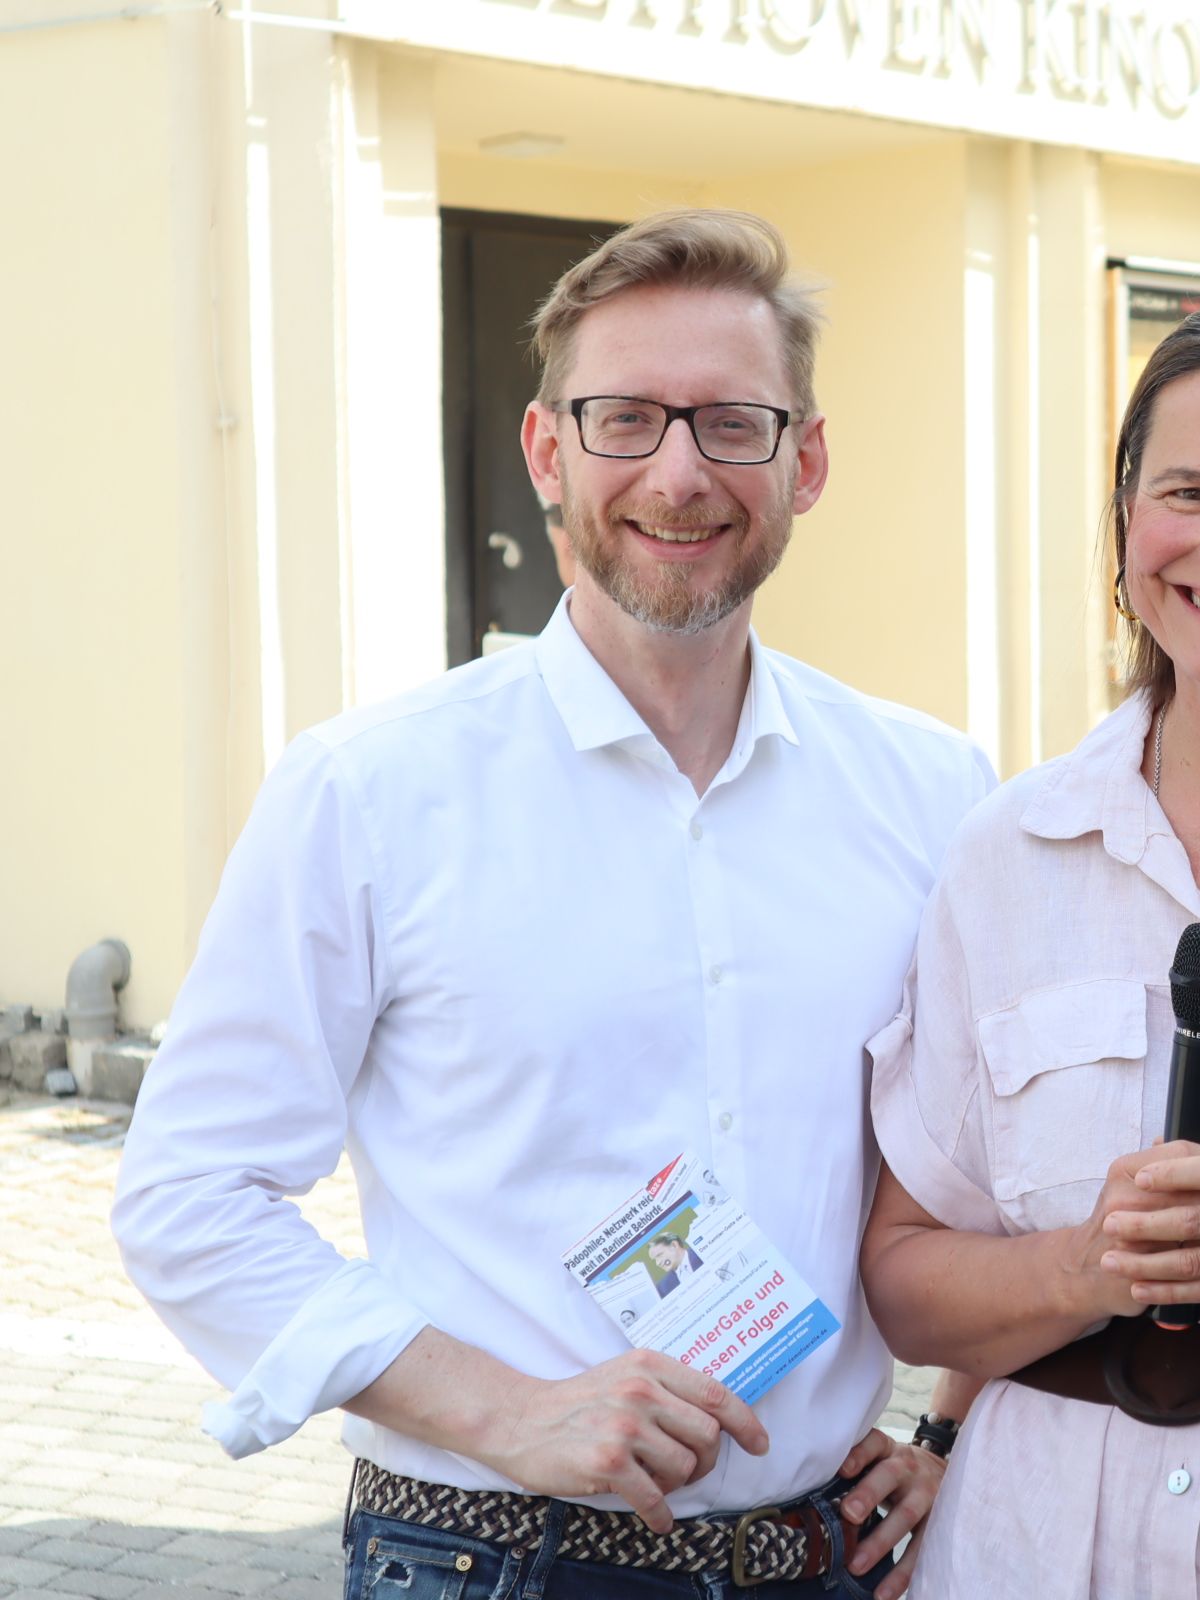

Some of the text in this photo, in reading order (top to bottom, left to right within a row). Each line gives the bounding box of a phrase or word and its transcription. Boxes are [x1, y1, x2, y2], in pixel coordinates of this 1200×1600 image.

[474, 0, 995, 87] OVEN
[563, 1233, 606, 1272] Pädophiles
[602, 1204, 639, 1238] Netzwerk
[577, 1259, 597, 1278] weit
[594, 1252, 605, 1263] in
[601, 1227, 634, 1257] Berliner
[675, 1294, 756, 1367] entlerGate
[751, 1269, 785, 1301] und
[735, 1296, 792, 1349] Folgen
